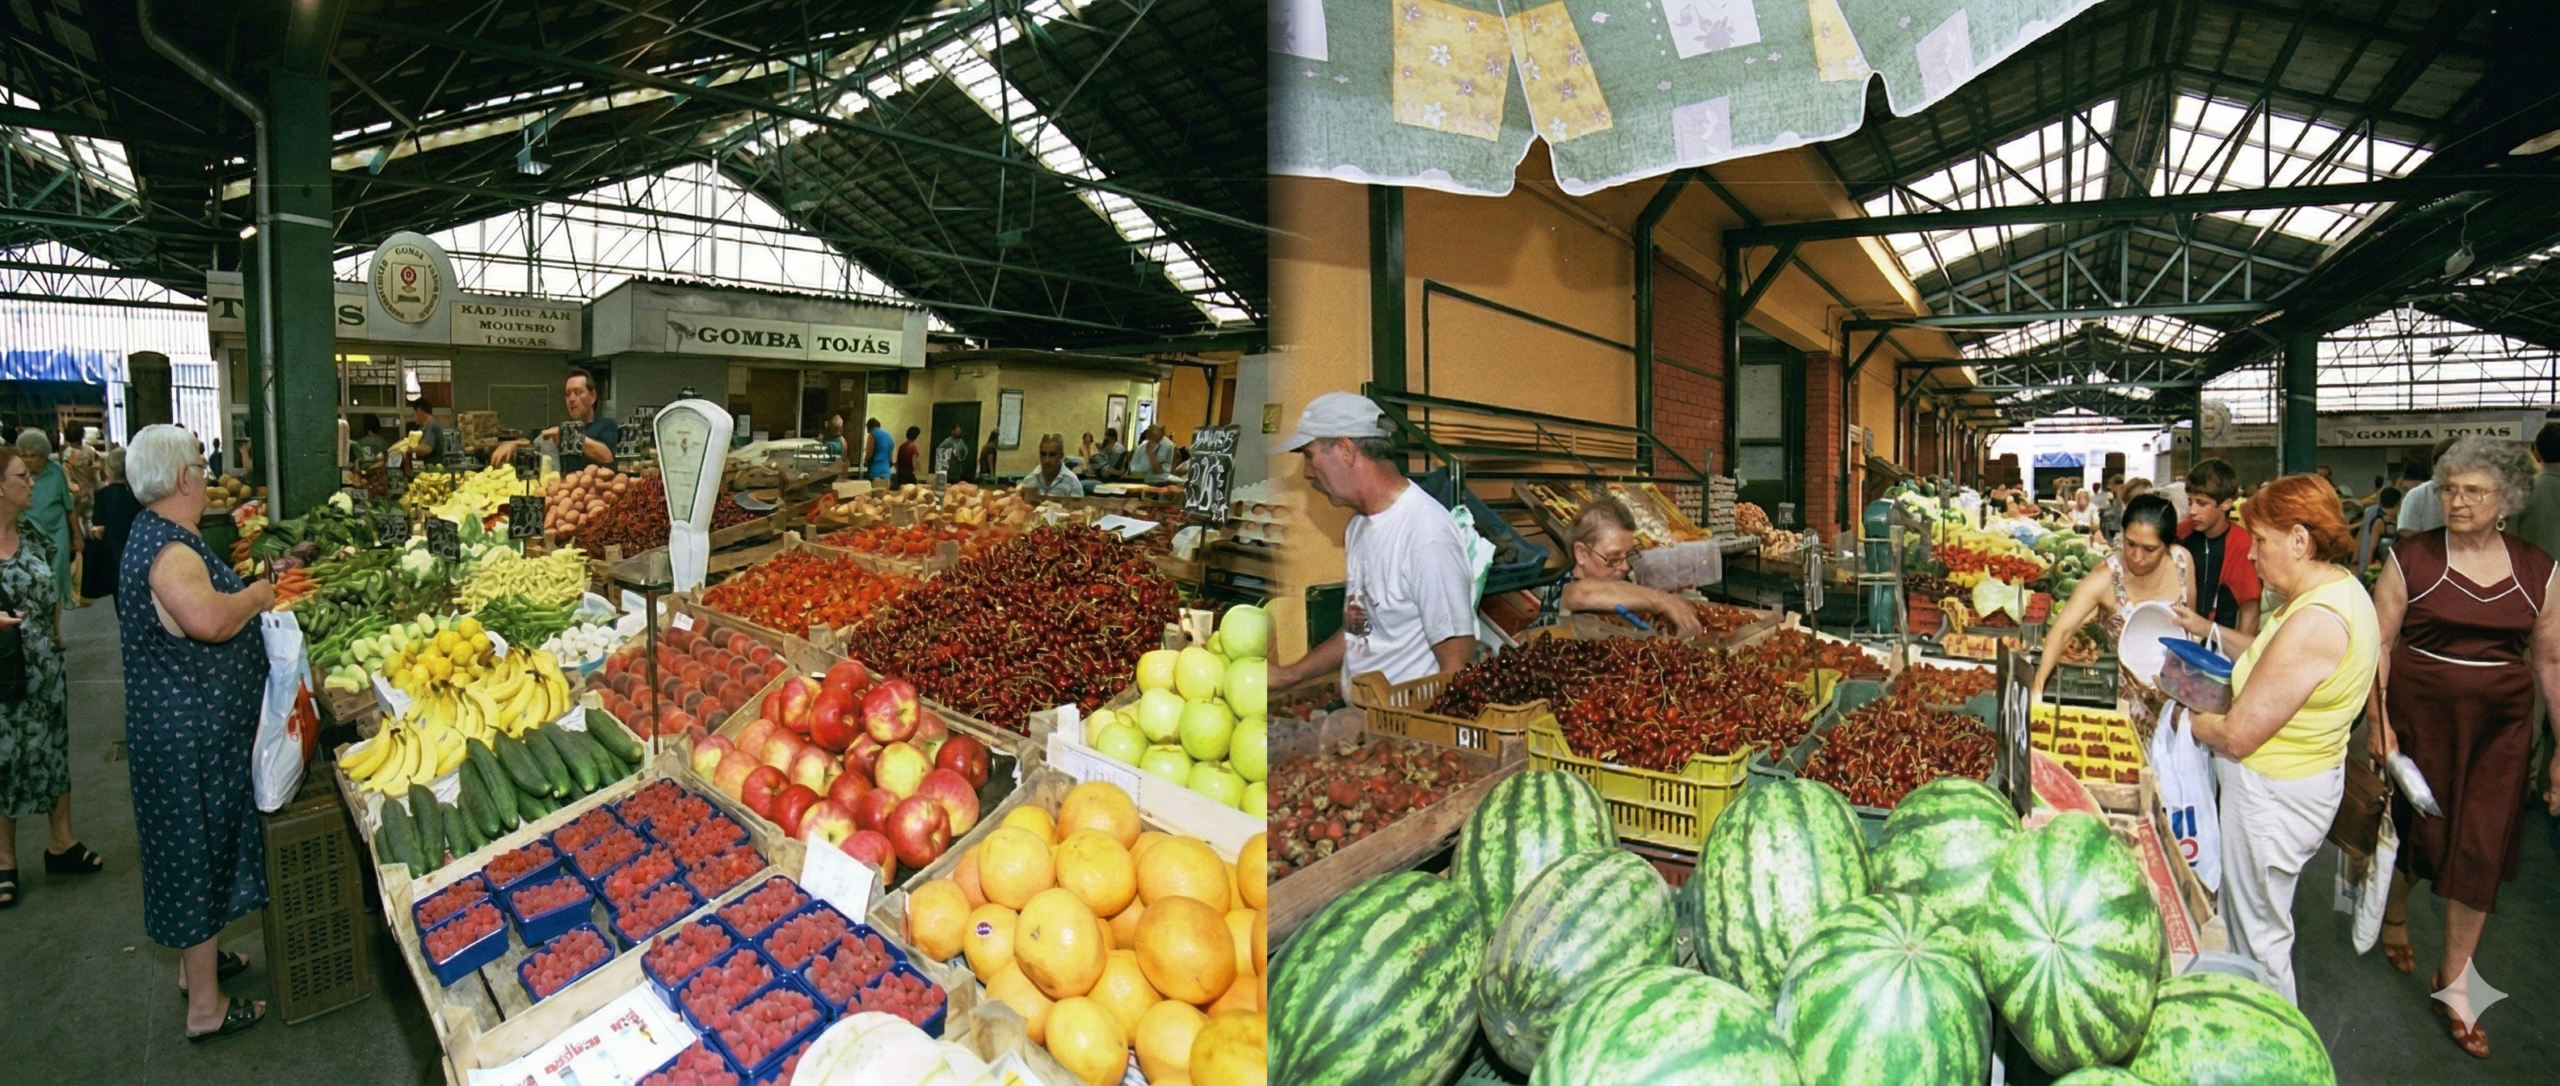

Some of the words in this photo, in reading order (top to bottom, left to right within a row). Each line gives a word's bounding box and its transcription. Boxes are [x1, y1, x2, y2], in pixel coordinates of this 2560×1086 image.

[698, 327, 803, 349] GOMBA
[817, 335, 891, 355] TOJÁS
[2356, 429, 2434, 440] GOMBA
